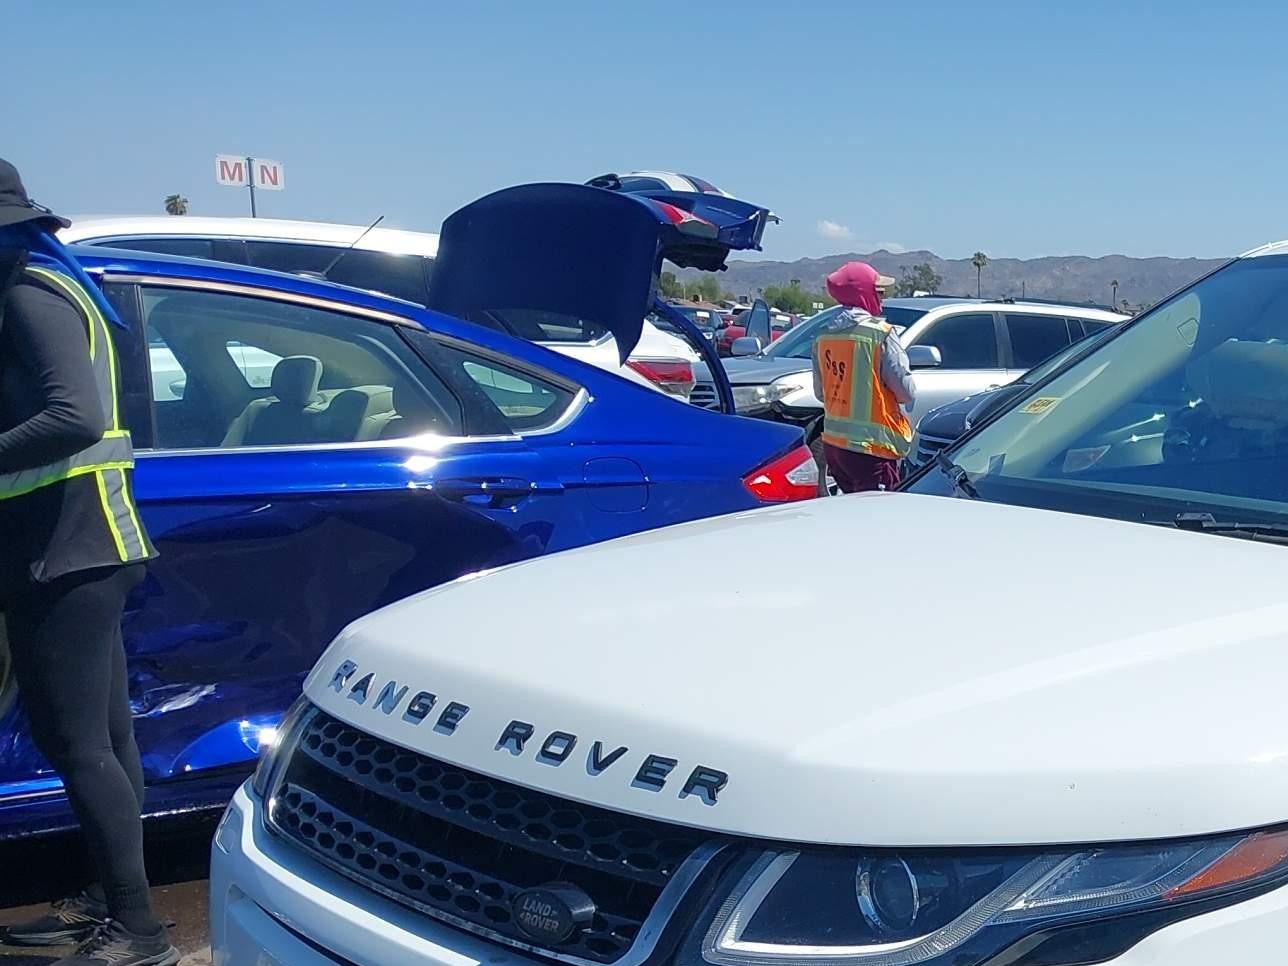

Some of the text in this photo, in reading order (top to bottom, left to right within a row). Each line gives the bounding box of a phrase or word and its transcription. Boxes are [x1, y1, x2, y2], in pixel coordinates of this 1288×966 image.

[219, 159, 243, 182] M
[260, 165, 279, 186] N
[329, 659, 730, 806] RANGE ROVER
[522, 897, 553, 917] LAND
[523, 912, 560, 932] ROVER
